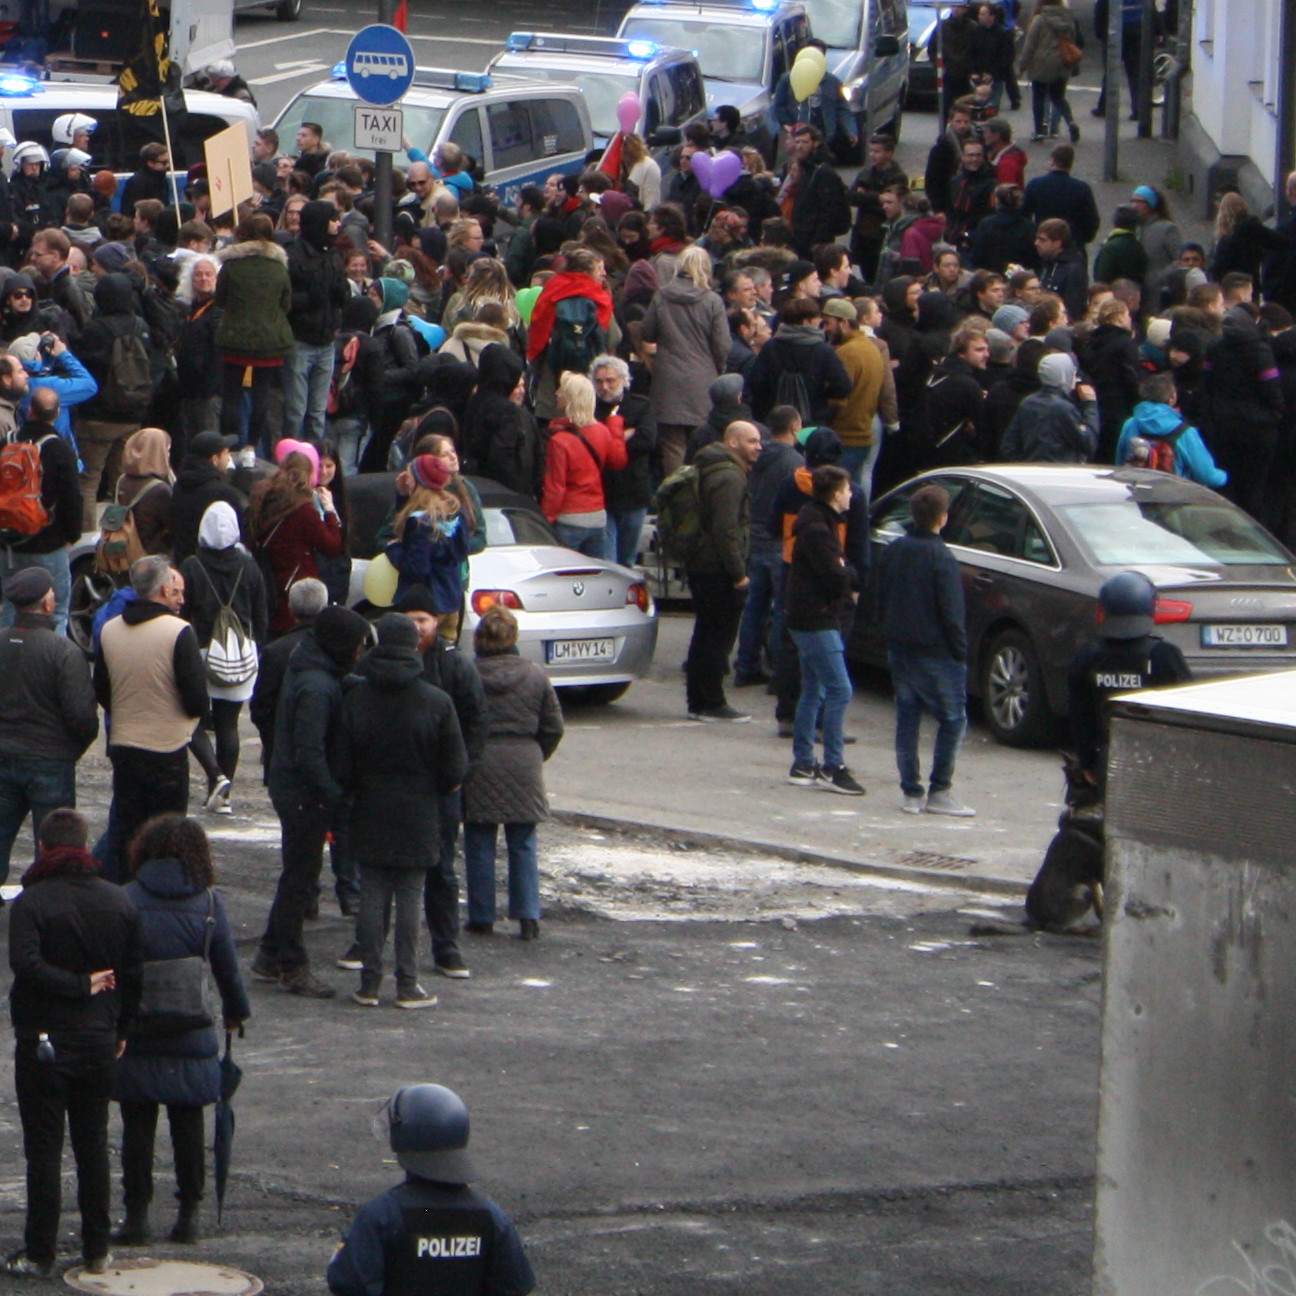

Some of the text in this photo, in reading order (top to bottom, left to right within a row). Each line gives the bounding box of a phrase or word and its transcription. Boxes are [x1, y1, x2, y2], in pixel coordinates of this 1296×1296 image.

[361, 114, 397, 133] TAXI
[371, 134, 387, 144] frei
[1216, 627, 1235, 643] WZ
[1254, 626, 1281, 642] 700
[555, 642, 570, 658] LM
[1096, 673, 1142, 689] POLIZEI
[417, 1236, 481, 1258] POLIZEI
